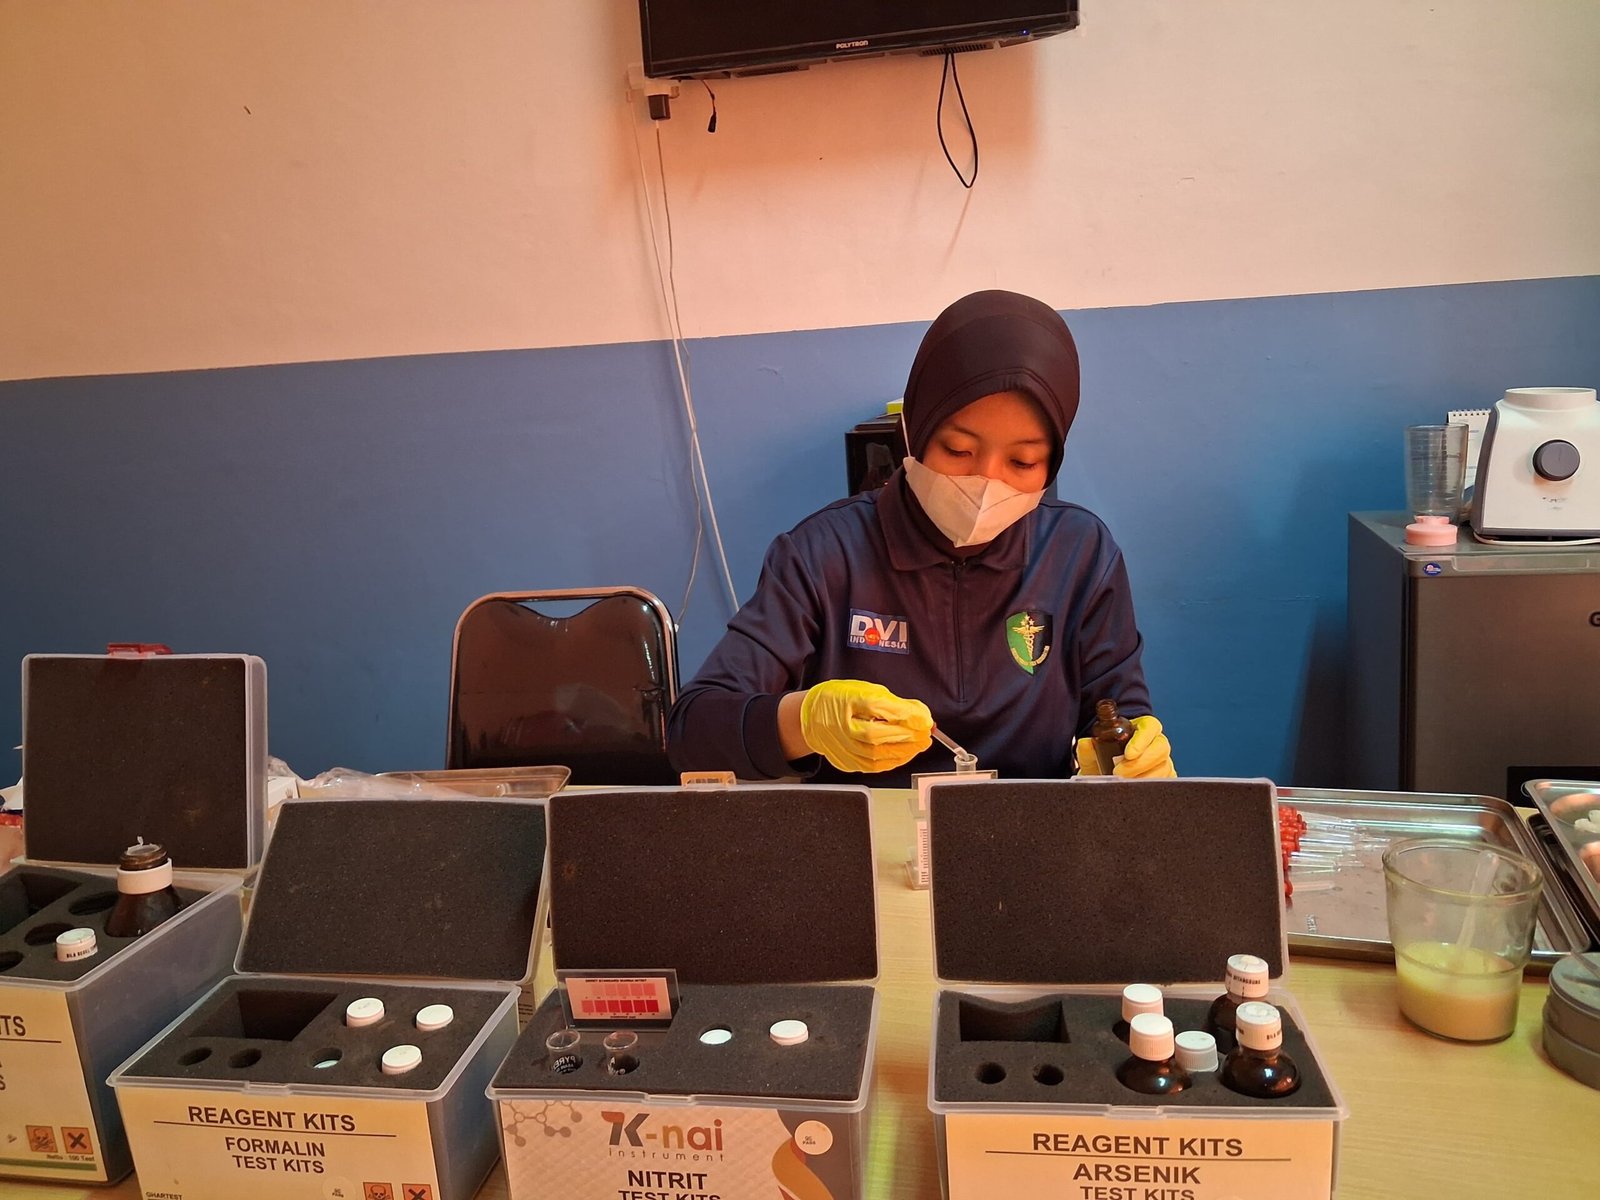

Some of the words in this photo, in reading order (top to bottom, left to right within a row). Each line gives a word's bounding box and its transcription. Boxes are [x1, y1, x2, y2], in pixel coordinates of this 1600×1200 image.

[836, 40, 869, 49] POLYTRON
[850, 614, 907, 642] DVI
[188, 1106, 296, 1129] REAGENT
[303, 1112, 356, 1132] KITS
[225, 1136, 325, 1157] FORMALIN
[609, 1148, 725, 1162] instrument
[1032, 1133, 1170, 1155] REAGENT
[1179, 1137, 1243, 1157] KITS
[232, 1155, 277, 1171] TEST
[283, 1158, 325, 1174] KITS
[1072, 1163, 1201, 1185] ARSENIK
[627, 1169, 707, 1190] NITRIT
[1080, 1186, 1137, 1200] TEST
[1144, 1188, 1195, 1200] KITS
